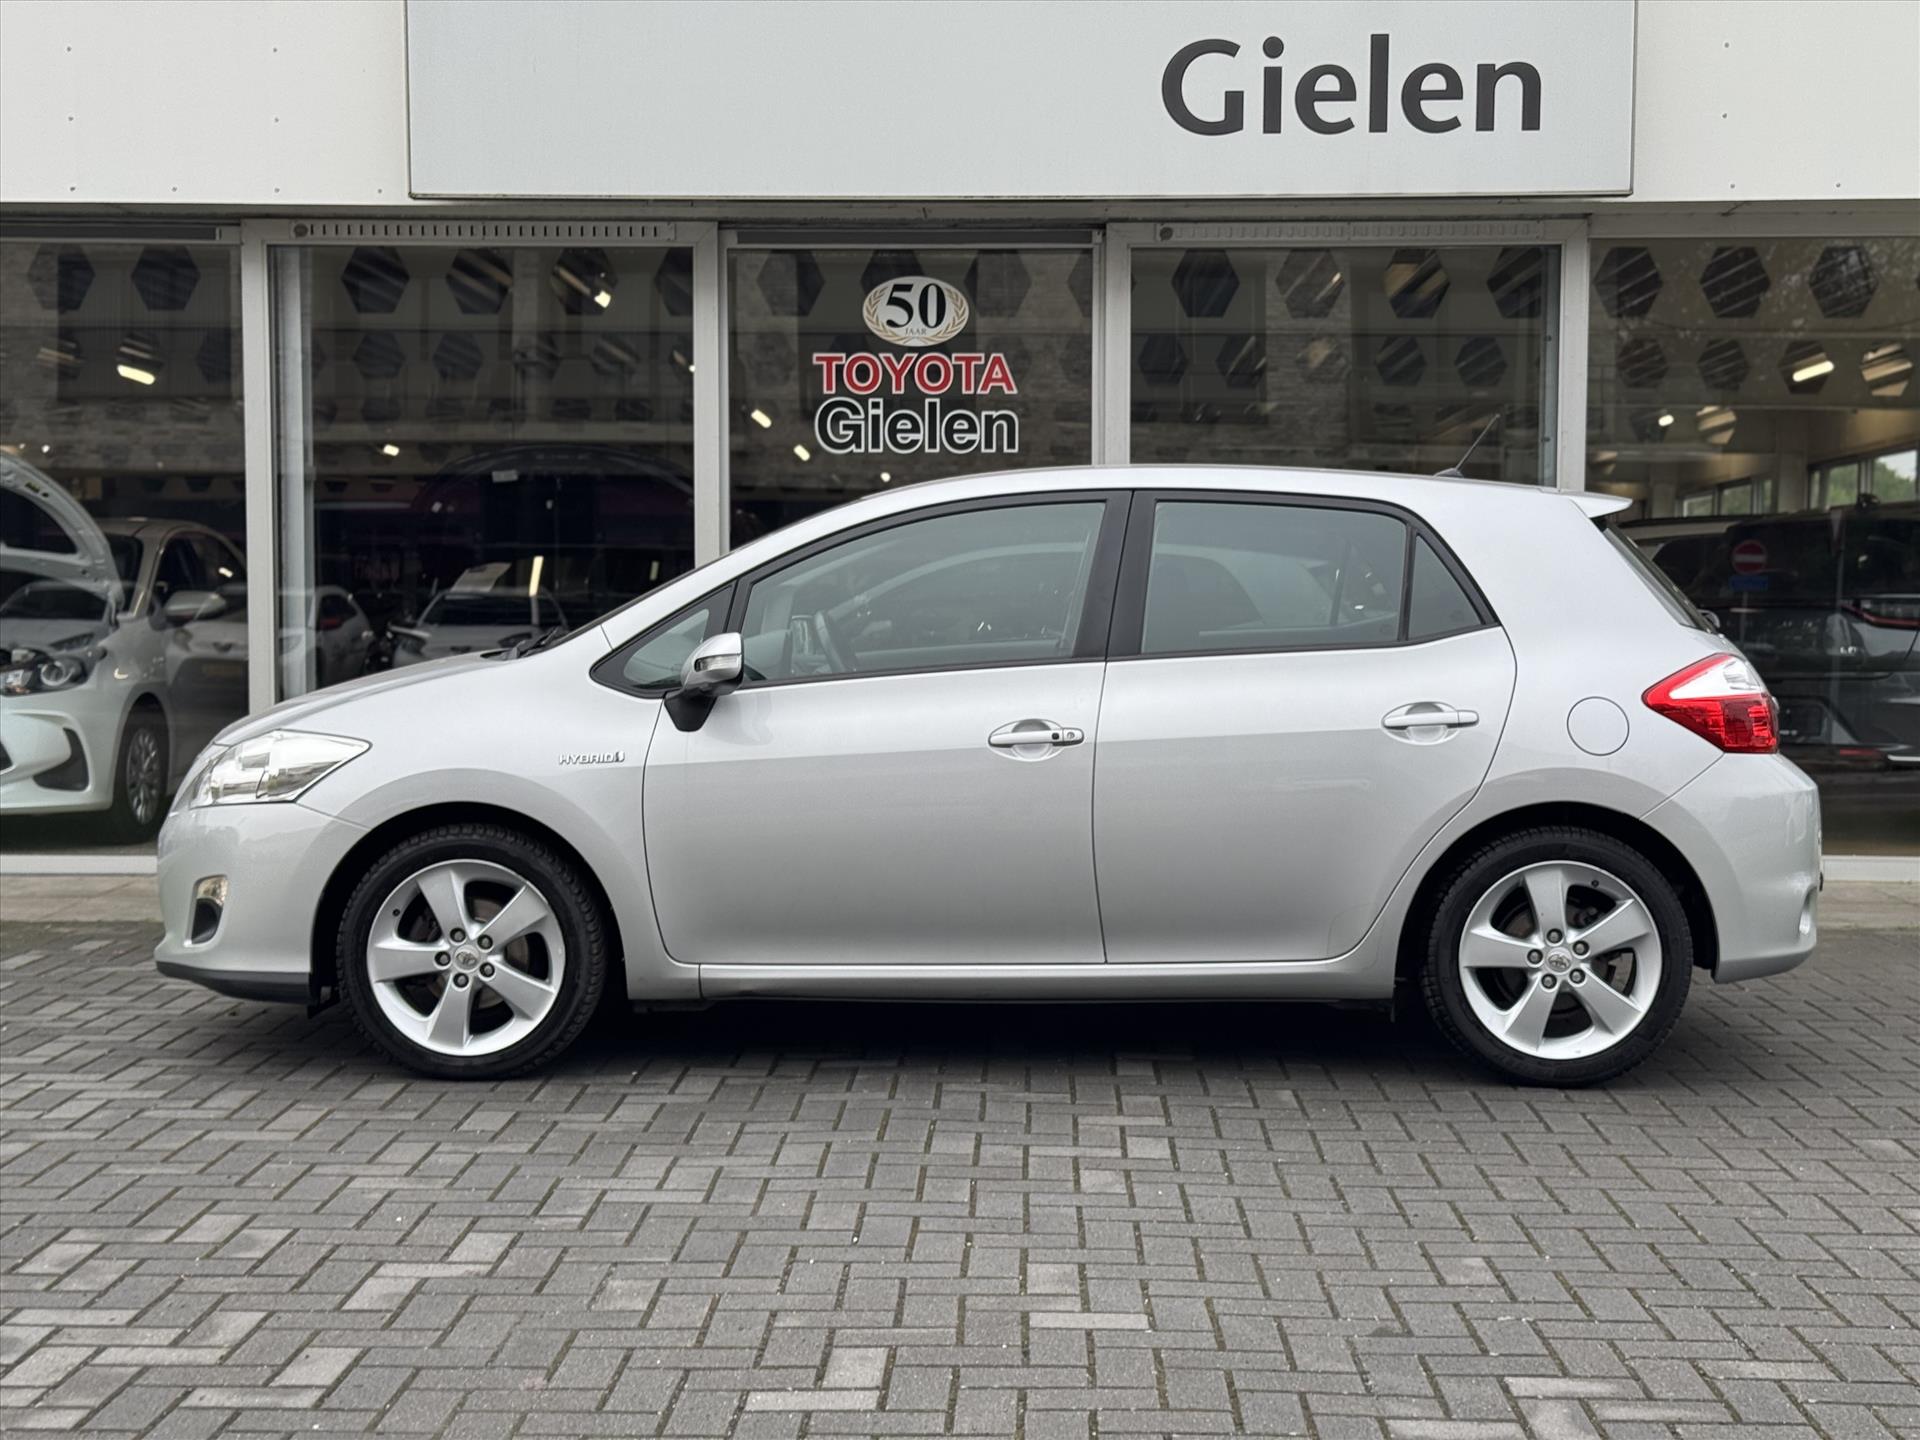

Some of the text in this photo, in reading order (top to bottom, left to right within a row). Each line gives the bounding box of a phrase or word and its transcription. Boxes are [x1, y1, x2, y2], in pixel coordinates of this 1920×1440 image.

[1161, 33, 1542, 136] Gielen
[886, 283, 946, 328] 50
[812, 352, 1018, 395] TOYOTA
[814, 397, 1019, 454] Gielen
[559, 752, 617, 765] HYBRID
